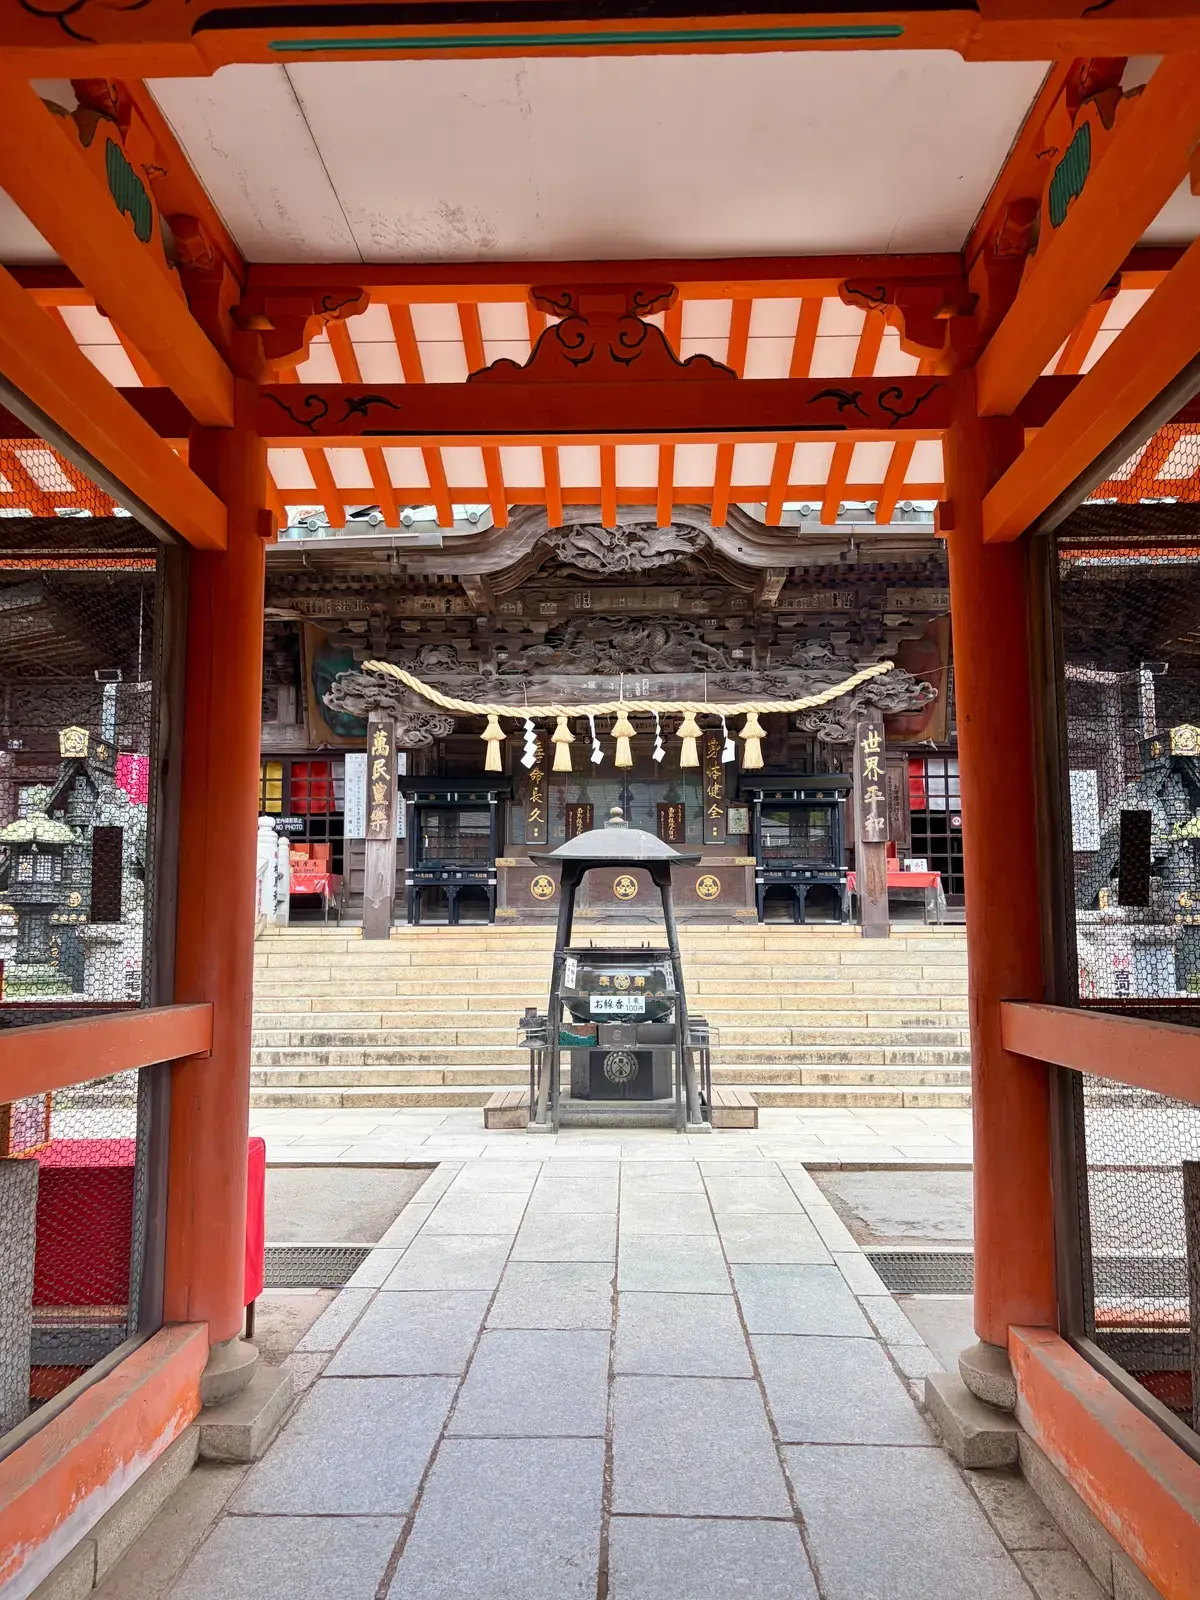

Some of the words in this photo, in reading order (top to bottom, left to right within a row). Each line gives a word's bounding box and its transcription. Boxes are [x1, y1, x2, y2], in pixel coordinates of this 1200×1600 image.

[860, 731, 886, 834] 世界平和
[594, 998, 625, 1010] お線香
[626, 1004, 644, 1012] 100円
